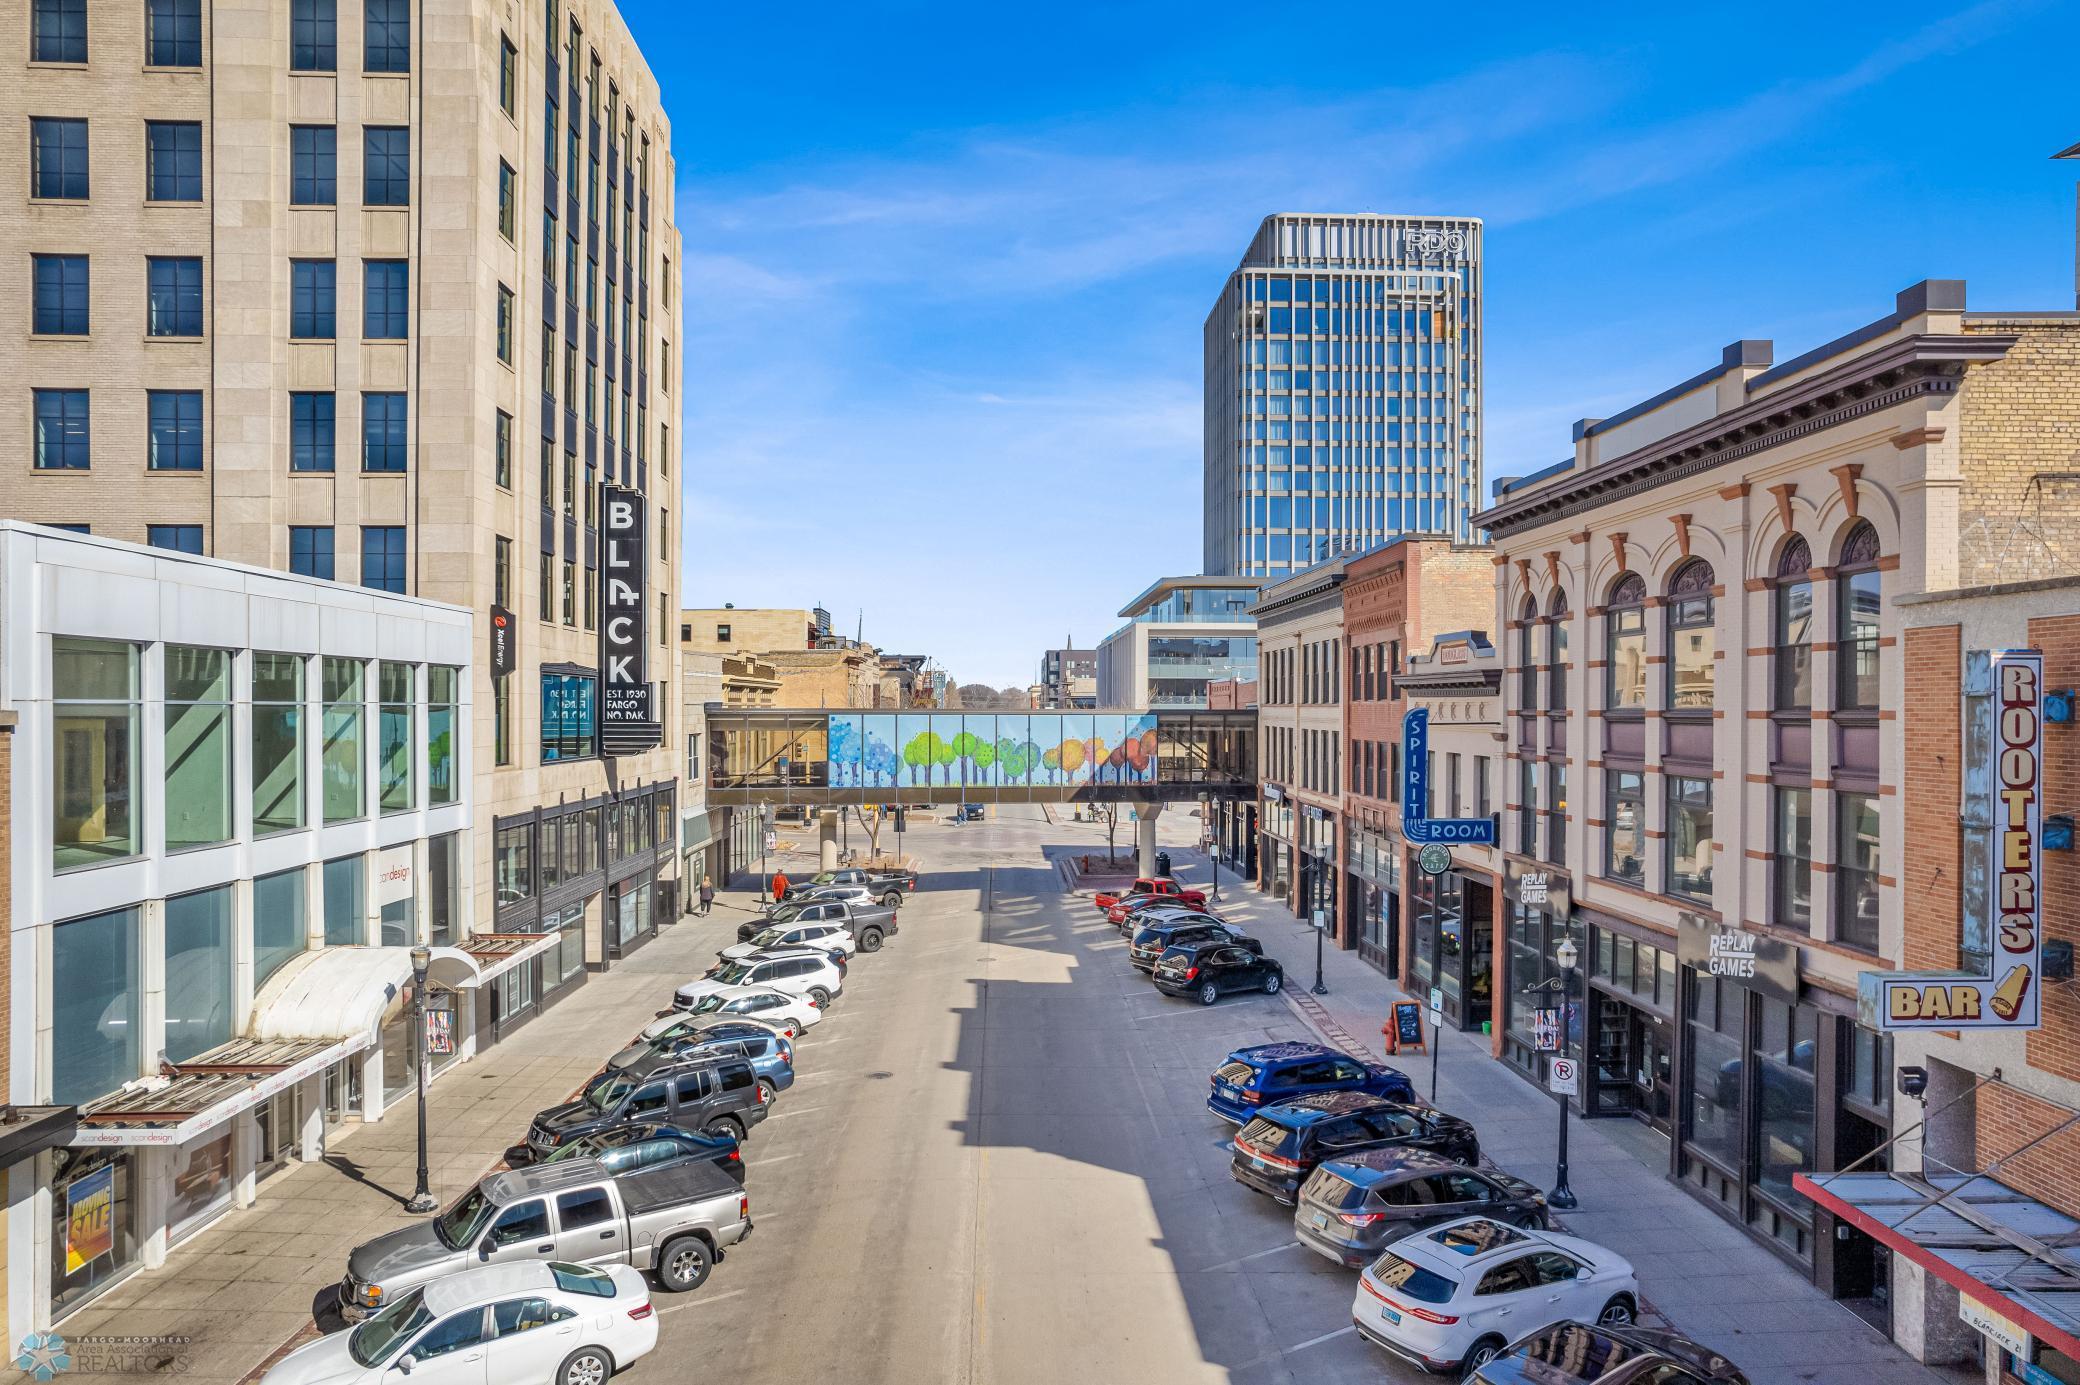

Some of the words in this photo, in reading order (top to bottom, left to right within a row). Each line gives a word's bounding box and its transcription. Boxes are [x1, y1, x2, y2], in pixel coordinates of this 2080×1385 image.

[1406, 231, 1467, 253] RDO
[608, 502, 640, 683] BLACK
[606, 689, 624, 699] EST.
[626, 689, 646, 699] 1930
[606, 700, 638, 709] FARGO
[606, 710, 624, 720] NO.
[626, 710, 646, 720] DAK.
[1409, 720, 1421, 817] SPIRIT
[1999, 664, 2037, 954] ROOTERS
[1431, 824, 1486, 838] ROOM
[1520, 872, 1548, 890] REPLAY
[1520, 889, 1548, 904] GAMES
[1709, 933, 1757, 957] REPLAY
[1708, 956, 1756, 978] GAMES
[1890, 986, 1981, 1020] BAR
[73, 1185, 111, 1222] MOVING
[71, 1206, 110, 1242] SALE
